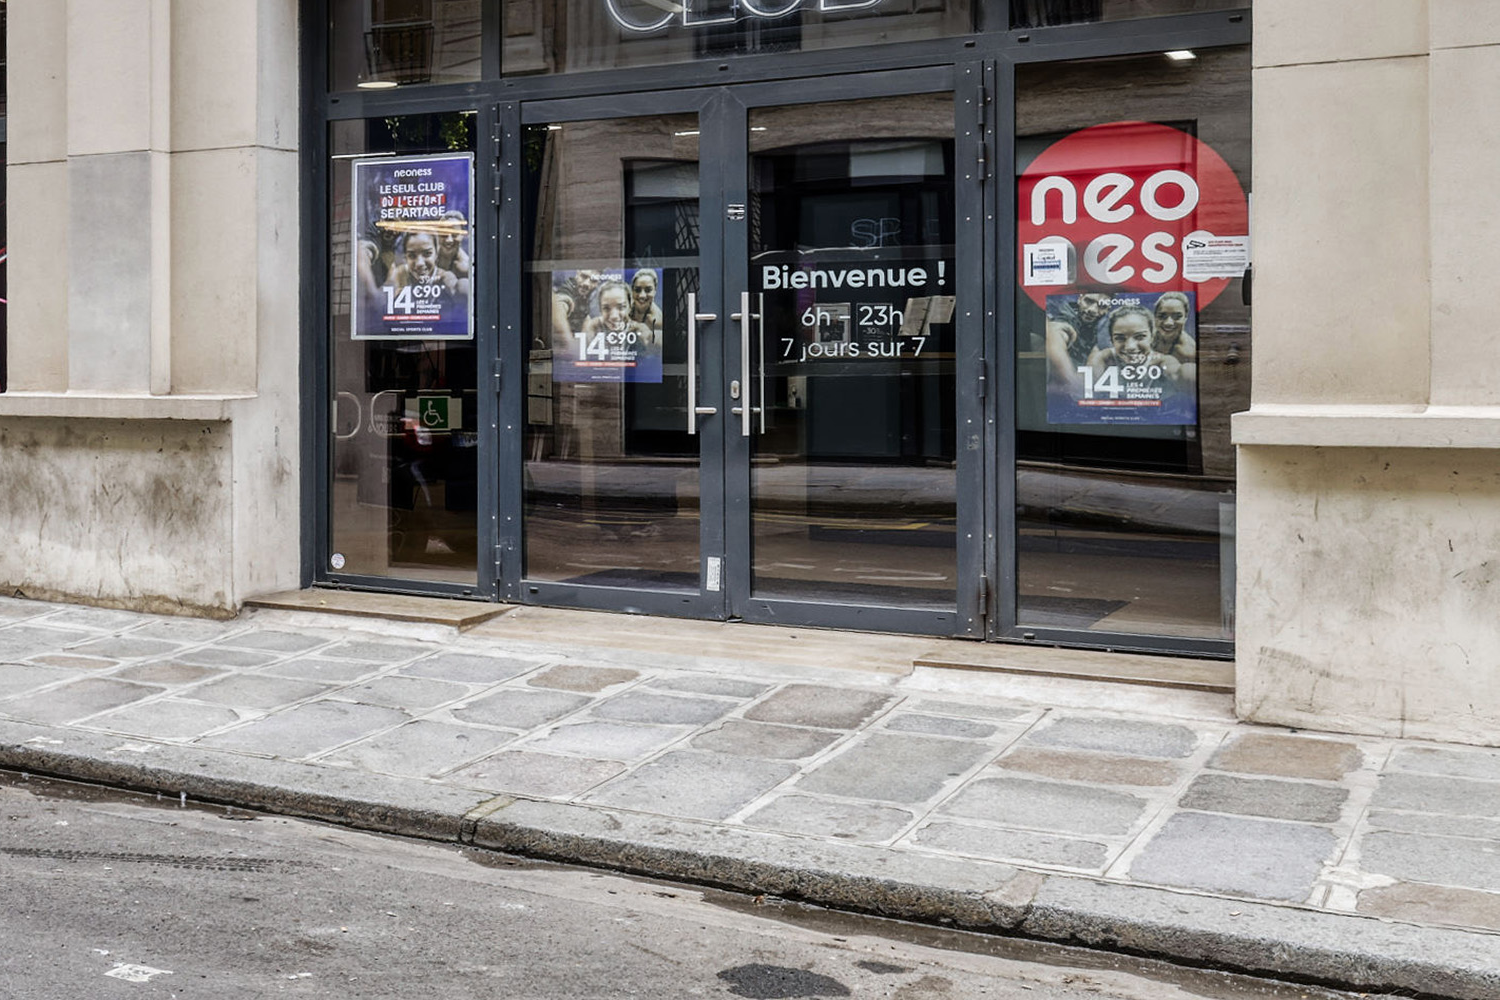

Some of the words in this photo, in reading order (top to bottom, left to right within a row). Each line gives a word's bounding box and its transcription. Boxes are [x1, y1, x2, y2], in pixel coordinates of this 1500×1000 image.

[393, 168, 432, 177] neoness
[380, 185, 391, 194] LE
[392, 184, 416, 193] SEUL
[417, 182, 445, 192] CLUB
[1031, 169, 1199, 225] neo
[380, 209, 395, 219] SE
[396, 206, 446, 218] PARTAGE
[762, 265, 927, 289] Bienvenue
[937, 261, 946, 286] !
[1098, 298, 1141, 306] neoness
[801, 306, 831, 326] 6h
[859, 305, 904, 326] 23h
[780, 338, 794, 357] 7
[799, 342, 860, 363] jours
[867, 342, 905, 357] sur
[911, 337, 926, 357] 7
